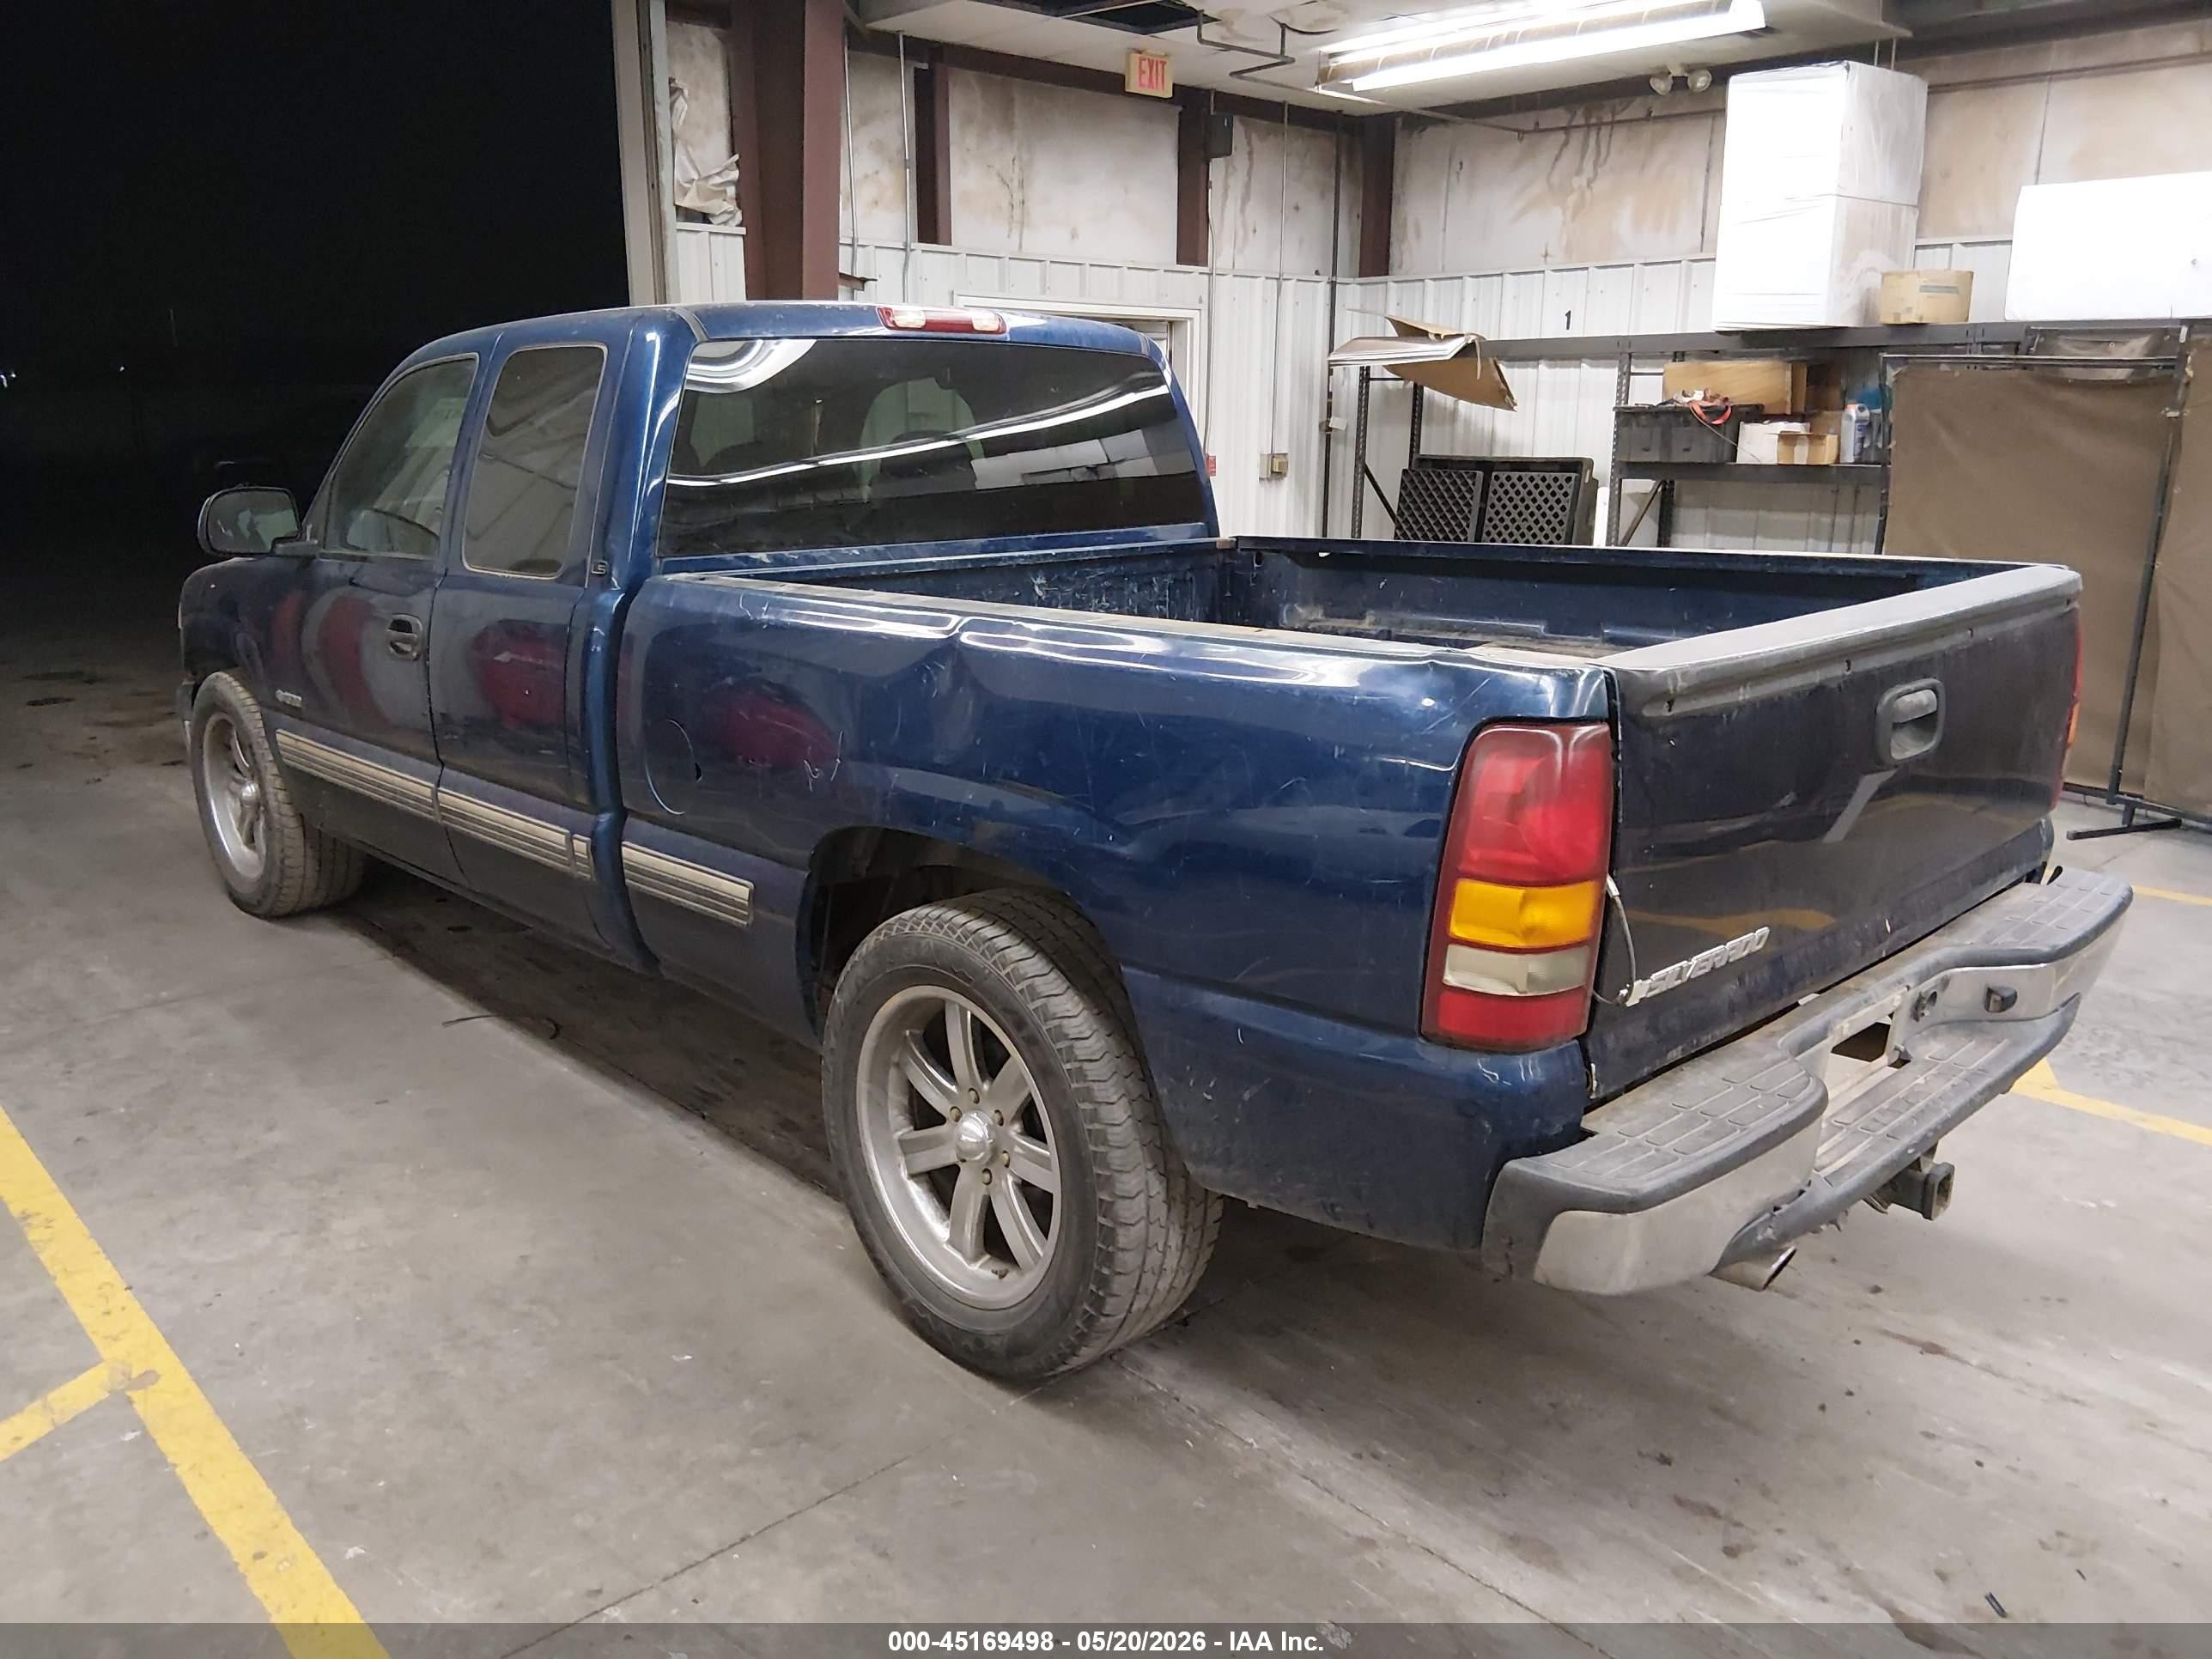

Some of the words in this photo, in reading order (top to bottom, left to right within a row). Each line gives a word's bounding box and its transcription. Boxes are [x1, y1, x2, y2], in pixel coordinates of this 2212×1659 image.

[1139, 56, 1167, 91] EXIT
[1565, 310, 1571, 331] 1
[1645, 927, 1771, 999] SILVERADO
